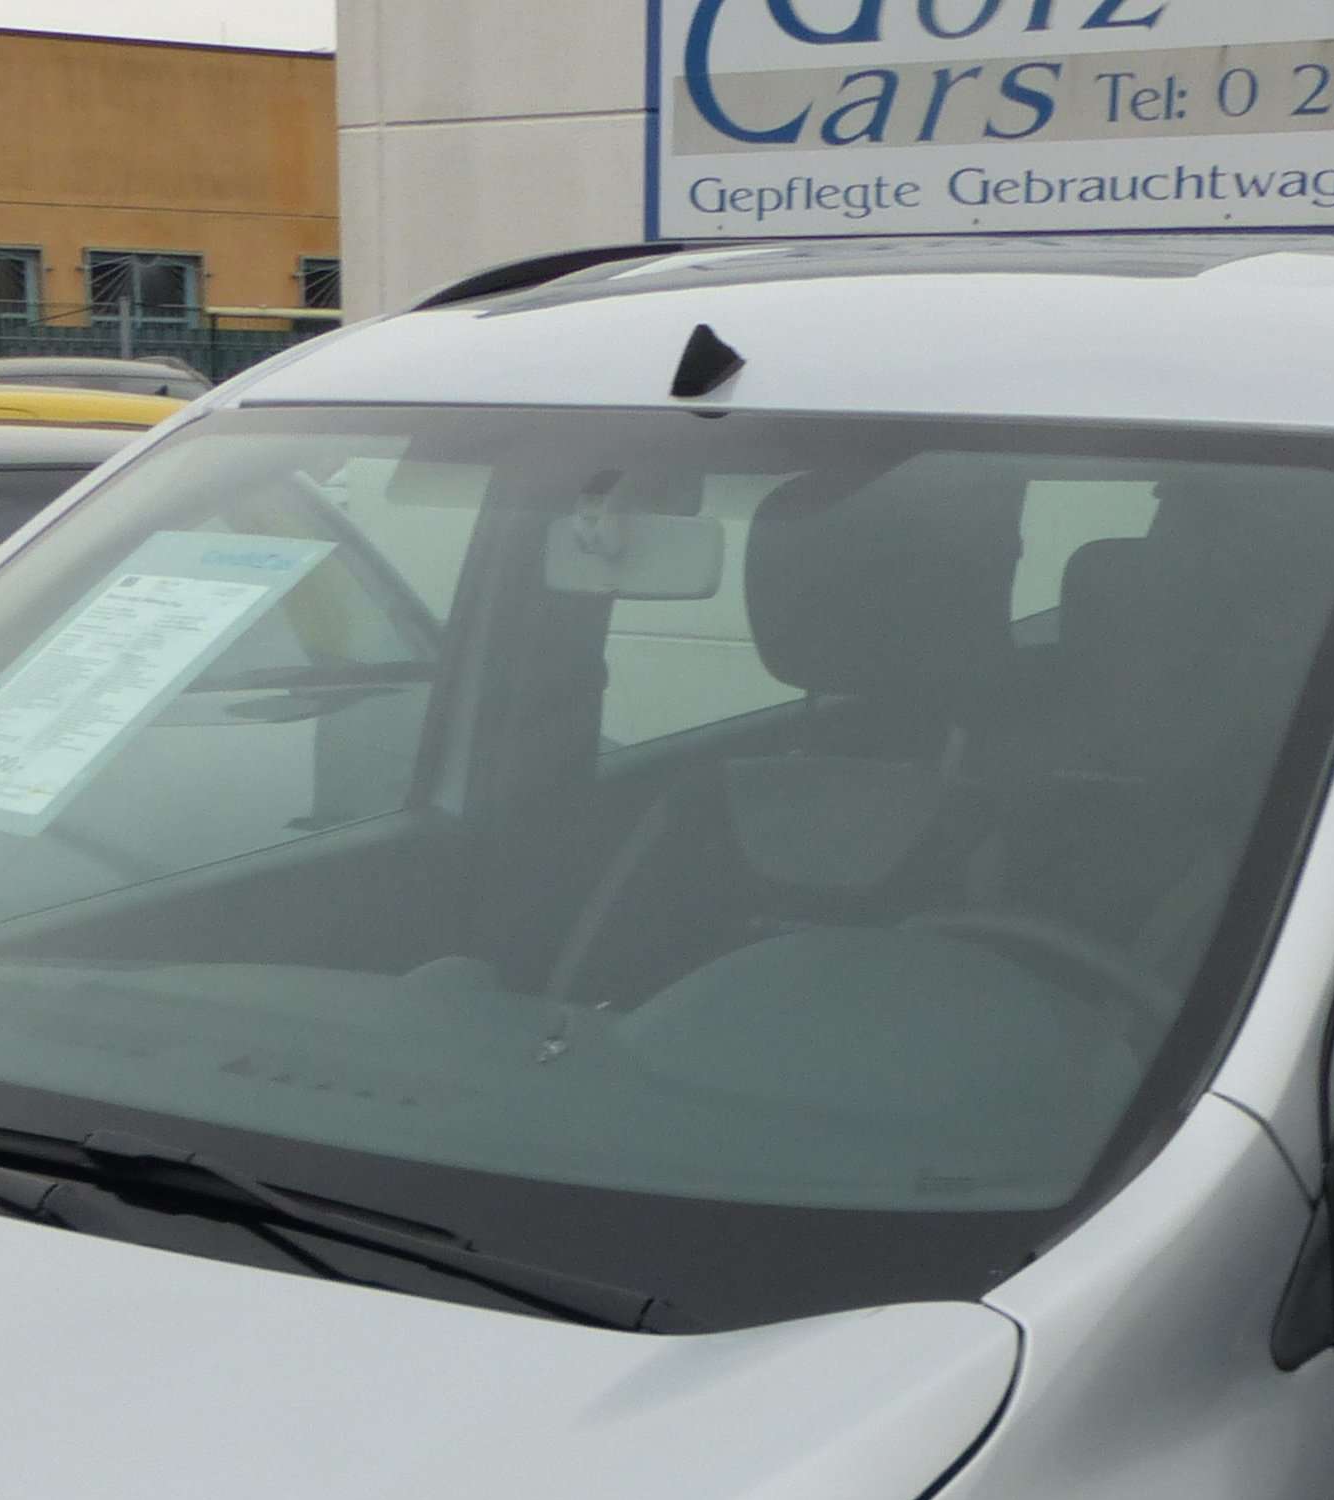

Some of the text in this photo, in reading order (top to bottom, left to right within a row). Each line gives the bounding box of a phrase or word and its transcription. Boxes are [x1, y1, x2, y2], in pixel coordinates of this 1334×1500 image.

[683, 0, 1063, 147] Cars
[1095, 72, 1188, 123] Tel:
[1217, 67, 1259, 118] 0
[688, 175, 922, 221] Gepflegte
